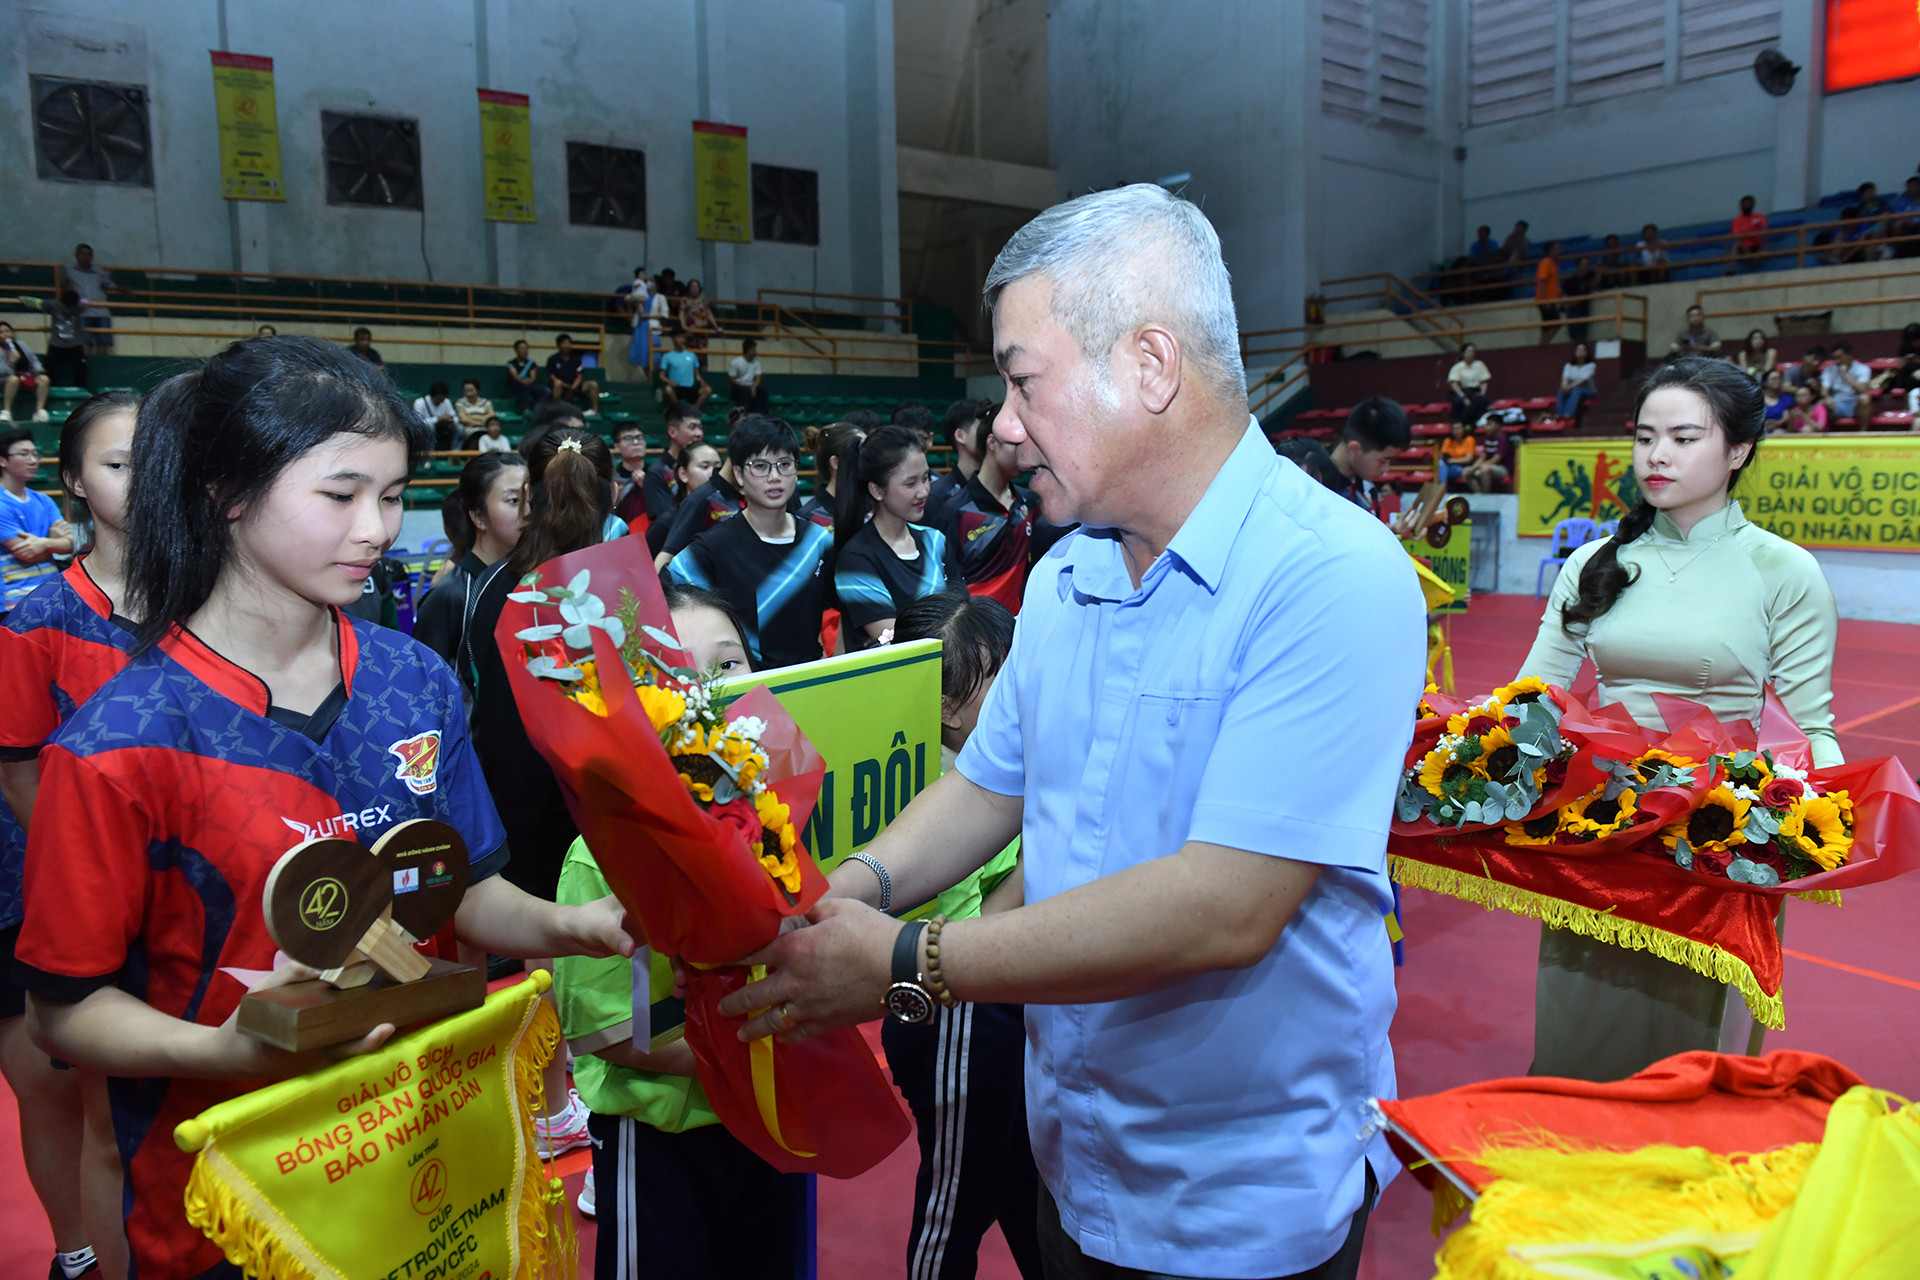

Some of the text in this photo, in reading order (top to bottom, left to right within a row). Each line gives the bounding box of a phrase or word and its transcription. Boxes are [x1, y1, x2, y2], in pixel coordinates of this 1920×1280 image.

[1770, 464, 1819, 489] GIẢI
[1829, 466, 1862, 490] VÔ
[1757, 491, 1805, 514] BÀN
[1812, 488, 1883, 517] QUỐC
[1891, 497, 1920, 517] GI
[1802, 516, 1872, 542] NHÂN
[1880, 518, 1920, 543] DÂ
[304, 882, 340, 919] 42
[336, 1043, 454, 1114] GIẢI VÔ ĐỊCH
[275, 1044, 496, 1176] BÓNG BÀN QUỐC GIA
[324, 1077, 482, 1184] BÁO NHÂN DÂN
[416, 1163, 442, 1204] 42
[378, 1187, 505, 1280] ETROVIETNAM
[428, 1204, 453, 1233] CÚP
